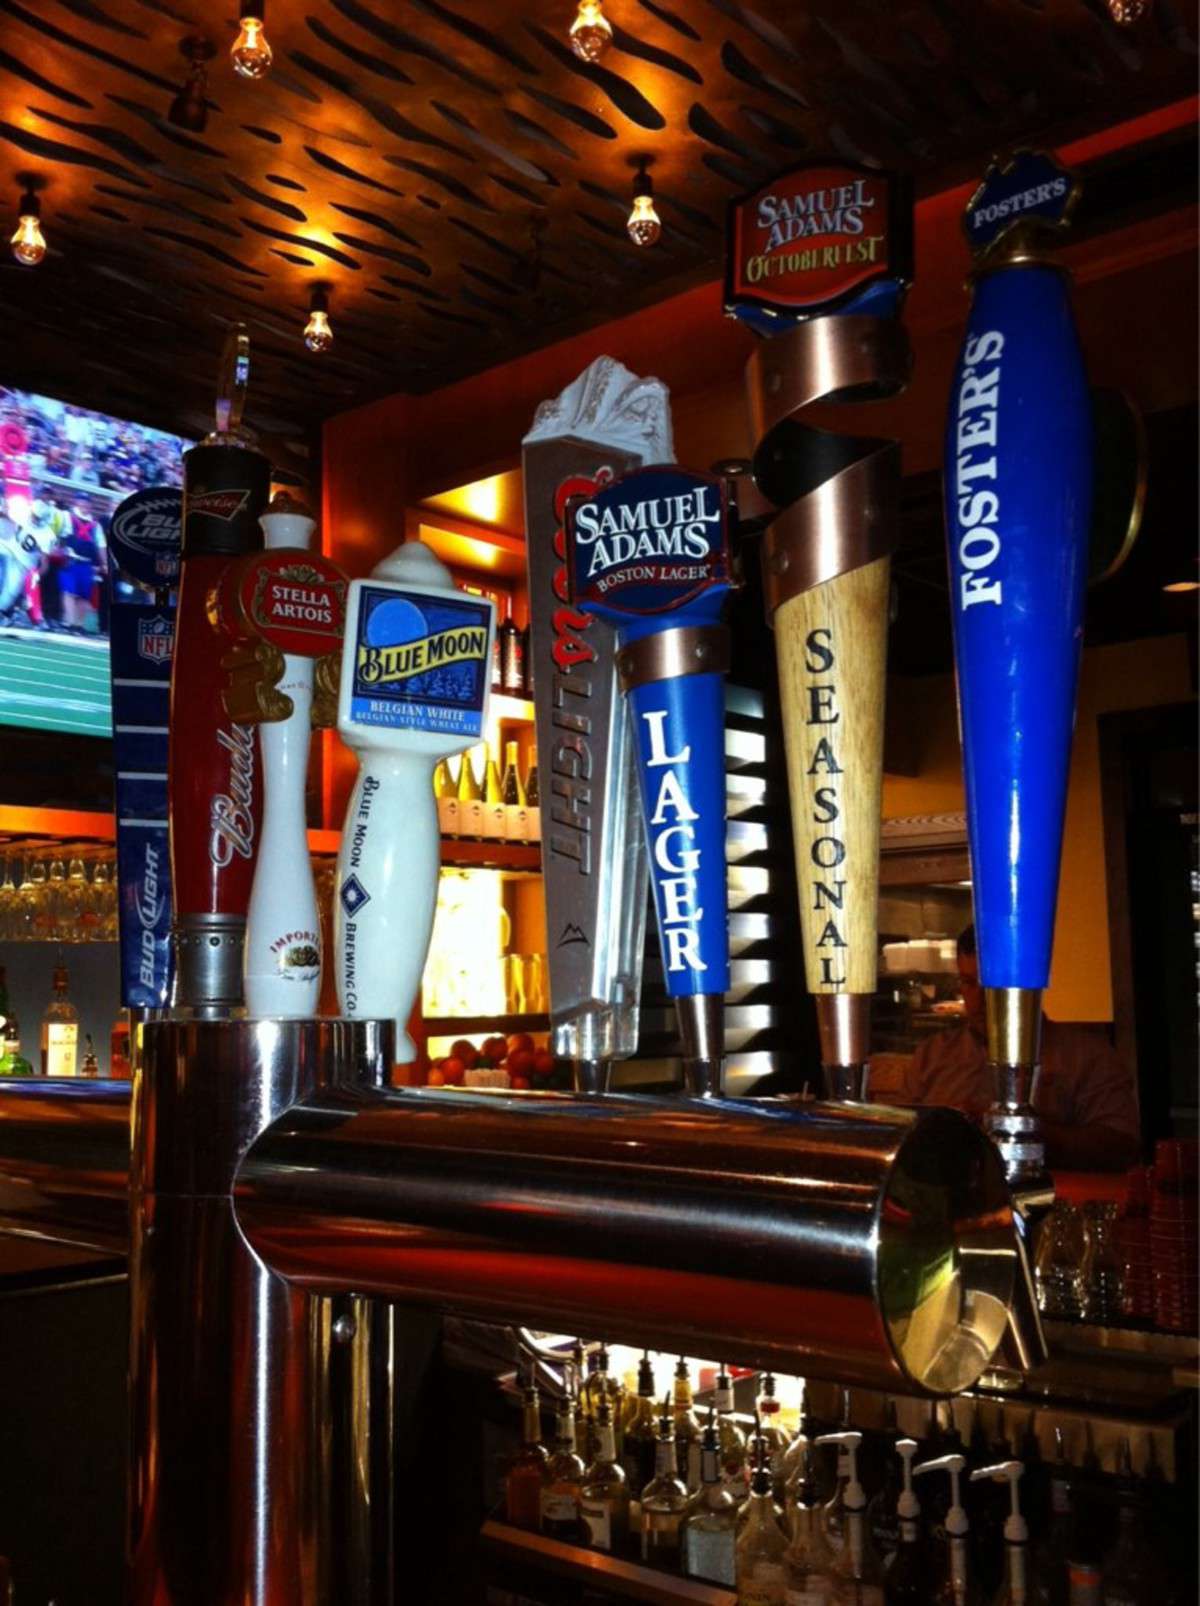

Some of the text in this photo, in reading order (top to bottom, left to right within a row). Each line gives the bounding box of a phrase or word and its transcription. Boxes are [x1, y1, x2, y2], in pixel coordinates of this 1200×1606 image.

[757, 180, 875, 228] SAMUEL
[764, 207, 864, 254] ADAMS
[973, 177, 1067, 229] FOSTER'S
[956, 330, 1005, 611] FOSTER'S
[575, 486, 721, 544] SAMUEL
[586, 522, 710, 578] ADAMS
[272, 584, 331, 608] STELLA
[597, 566, 657, 593] BOSTON
[272, 603, 332, 624] ARTOIS
[359, 631, 484, 683] BLUE MOON
[370, 701, 465, 722] BELGIAN WHITE
[550, 674, 593, 876] LIGHT
[350, 775, 380, 868] BLUE MOON
[805, 628, 848, 984] SEASONAL
[642, 710, 708, 972] LAGER
[139, 842, 160, 989] BUD LIGHT
[345, 922, 357, 989] BREWING
